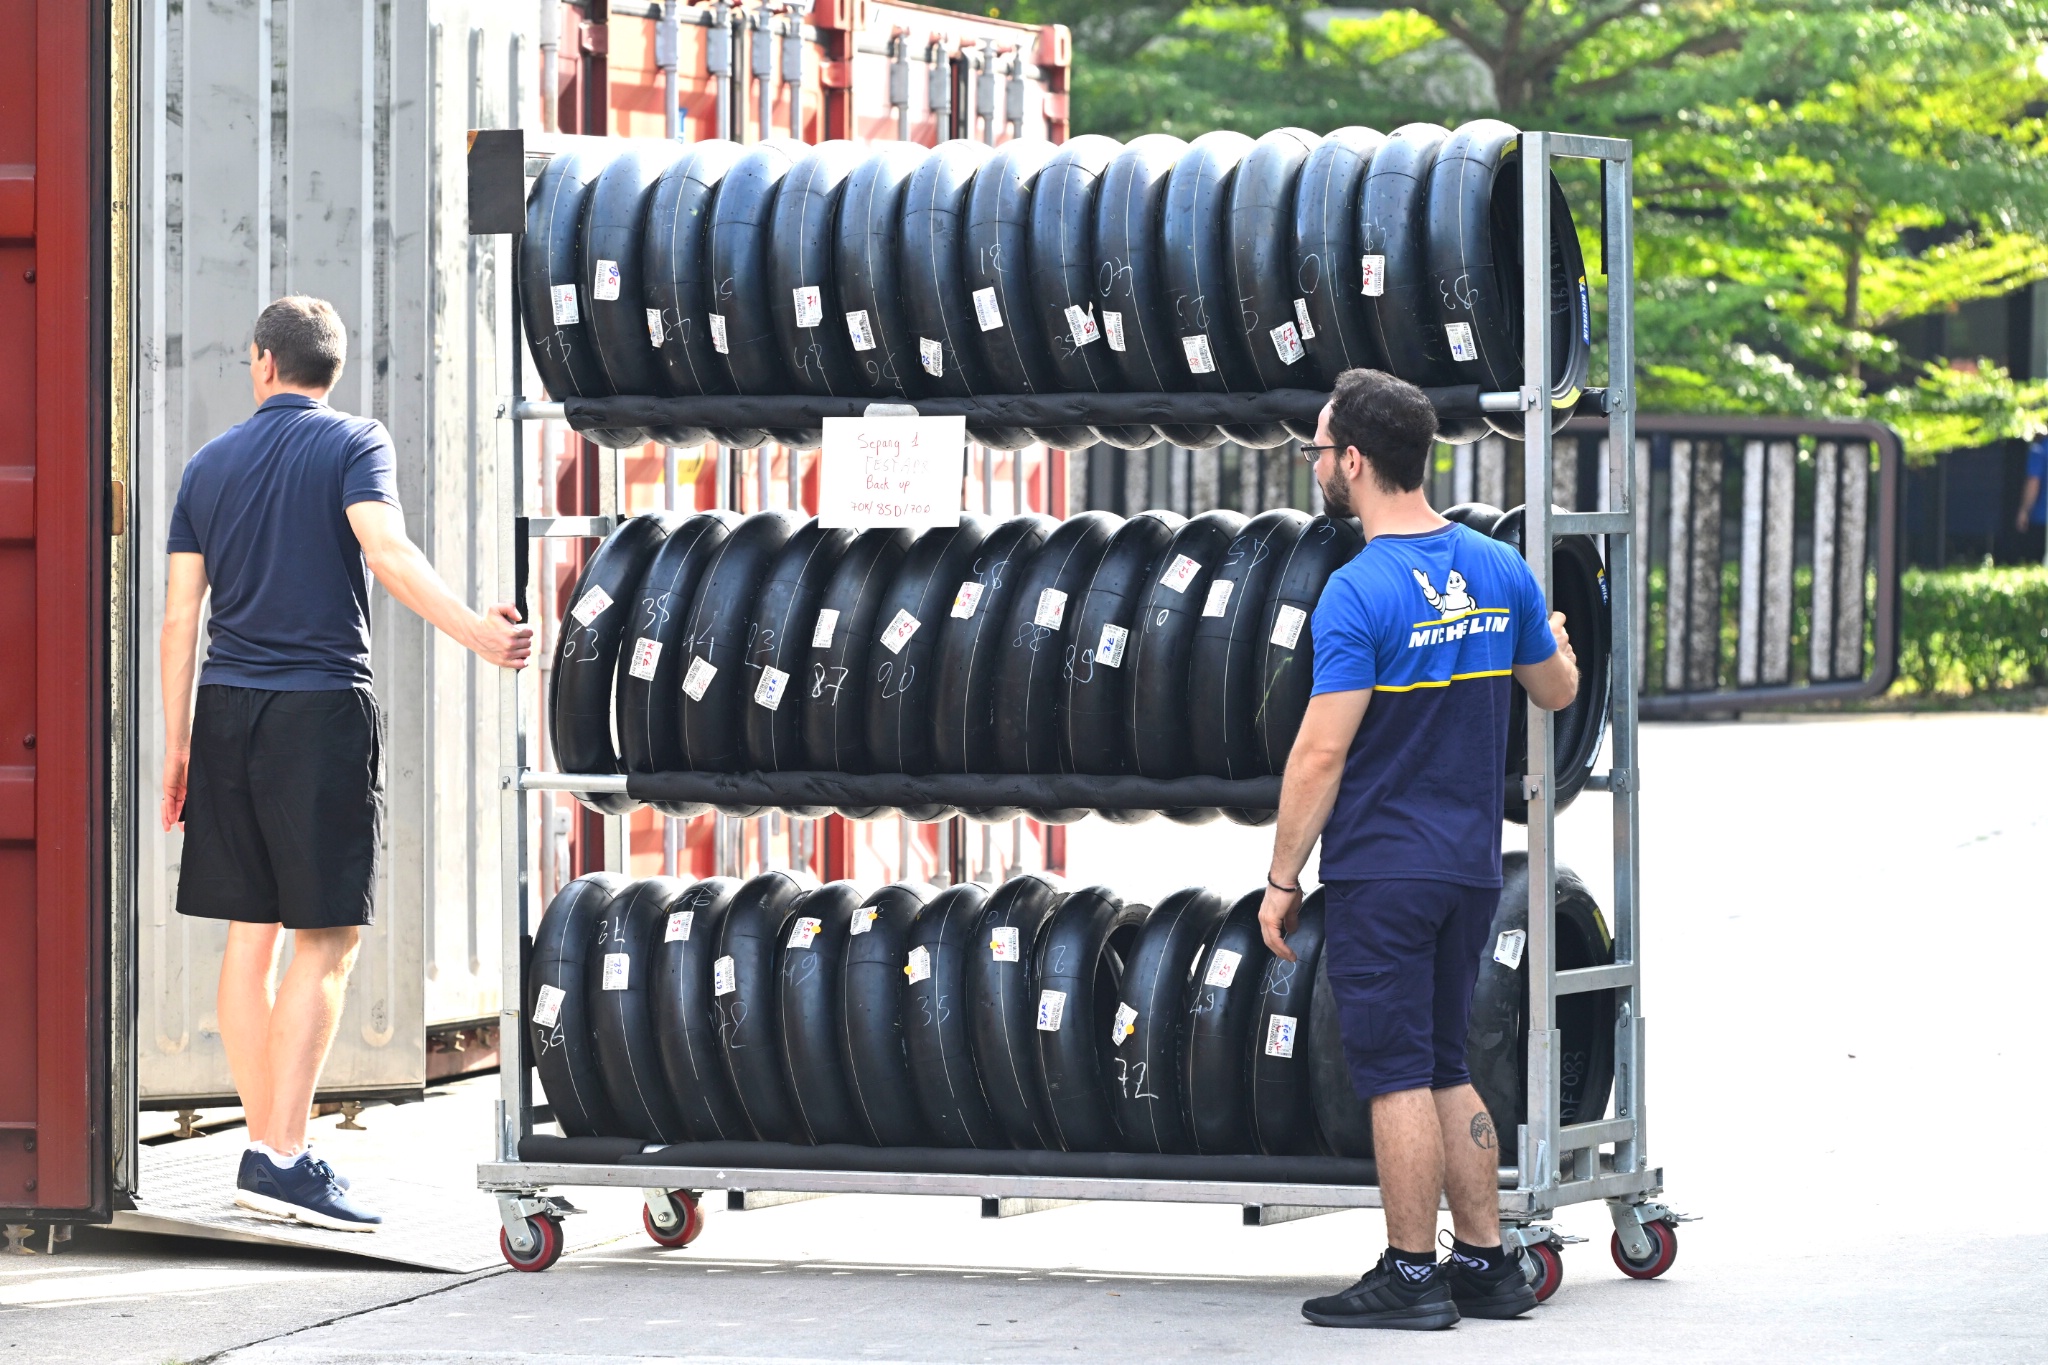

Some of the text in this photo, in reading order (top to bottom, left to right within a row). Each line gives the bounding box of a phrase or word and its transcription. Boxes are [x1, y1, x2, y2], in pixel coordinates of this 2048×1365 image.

[1581, 294, 1590, 341] MICHELIN
[857, 432, 919, 457] Sepang 1
[866, 474, 910, 493] Back up
[642, 592, 671, 630] 38
[1408, 616, 1510, 648] MICHELIN
[811, 662, 849, 706] 87
[538, 1023, 565, 1055] 36
[1114, 1057, 1159, 1099] 72
